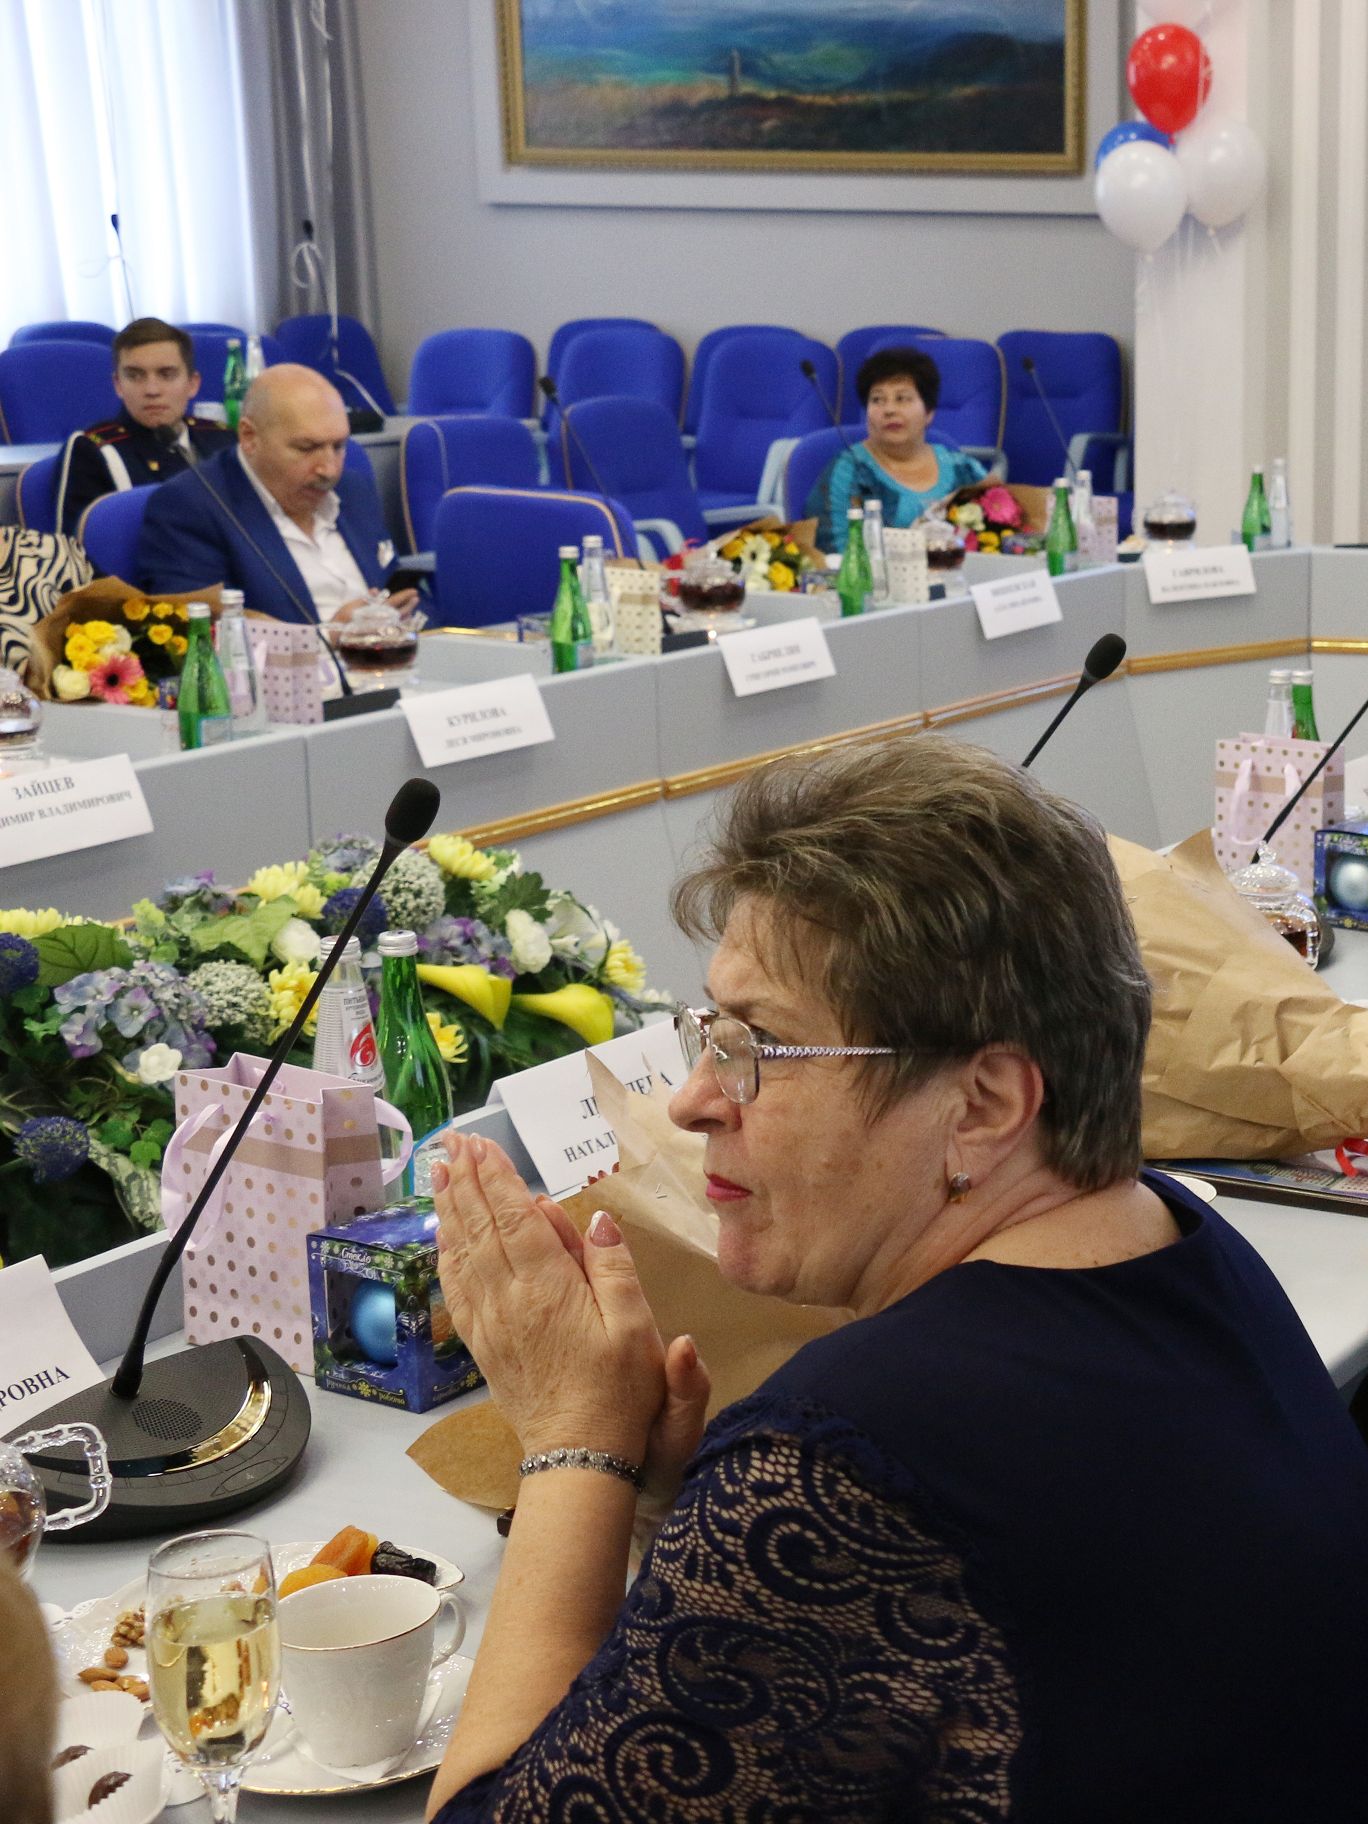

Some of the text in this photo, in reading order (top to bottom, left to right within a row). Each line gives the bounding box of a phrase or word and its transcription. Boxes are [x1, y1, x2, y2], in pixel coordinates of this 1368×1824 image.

[11, 775, 76, 801] ЗАЙЦЕВ
[0, 789, 133, 829] ИМИР ВЛАДИМИРОВИЧ
